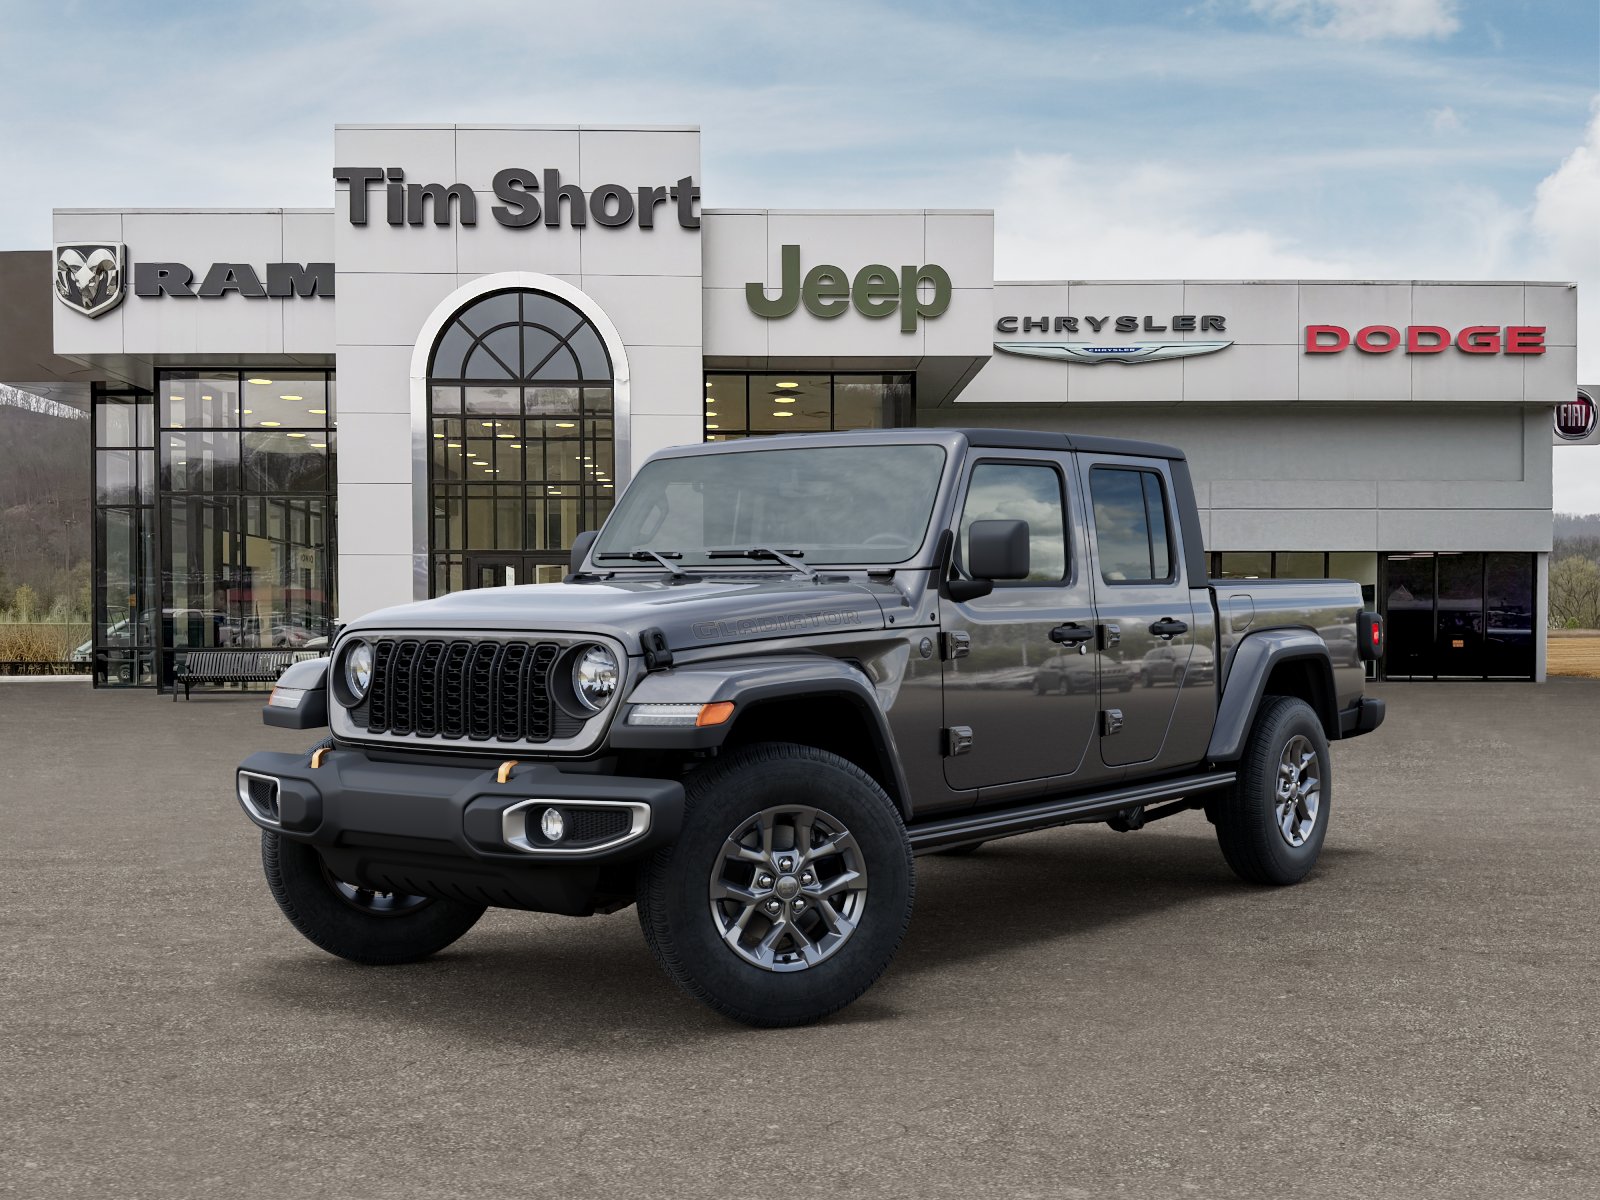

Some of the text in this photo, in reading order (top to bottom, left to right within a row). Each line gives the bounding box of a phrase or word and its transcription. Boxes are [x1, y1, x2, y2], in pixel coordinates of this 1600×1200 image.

[332, 167, 701, 229] Tim Short
[134, 262, 336, 298] RAM
[745, 244, 953, 333] Jeep
[997, 315, 1227, 333] CHRYSLER
[1304, 324, 1547, 355] DODGE
[1560, 404, 1586, 427] FIAT
[691, 609, 862, 640] GLADIATOR
